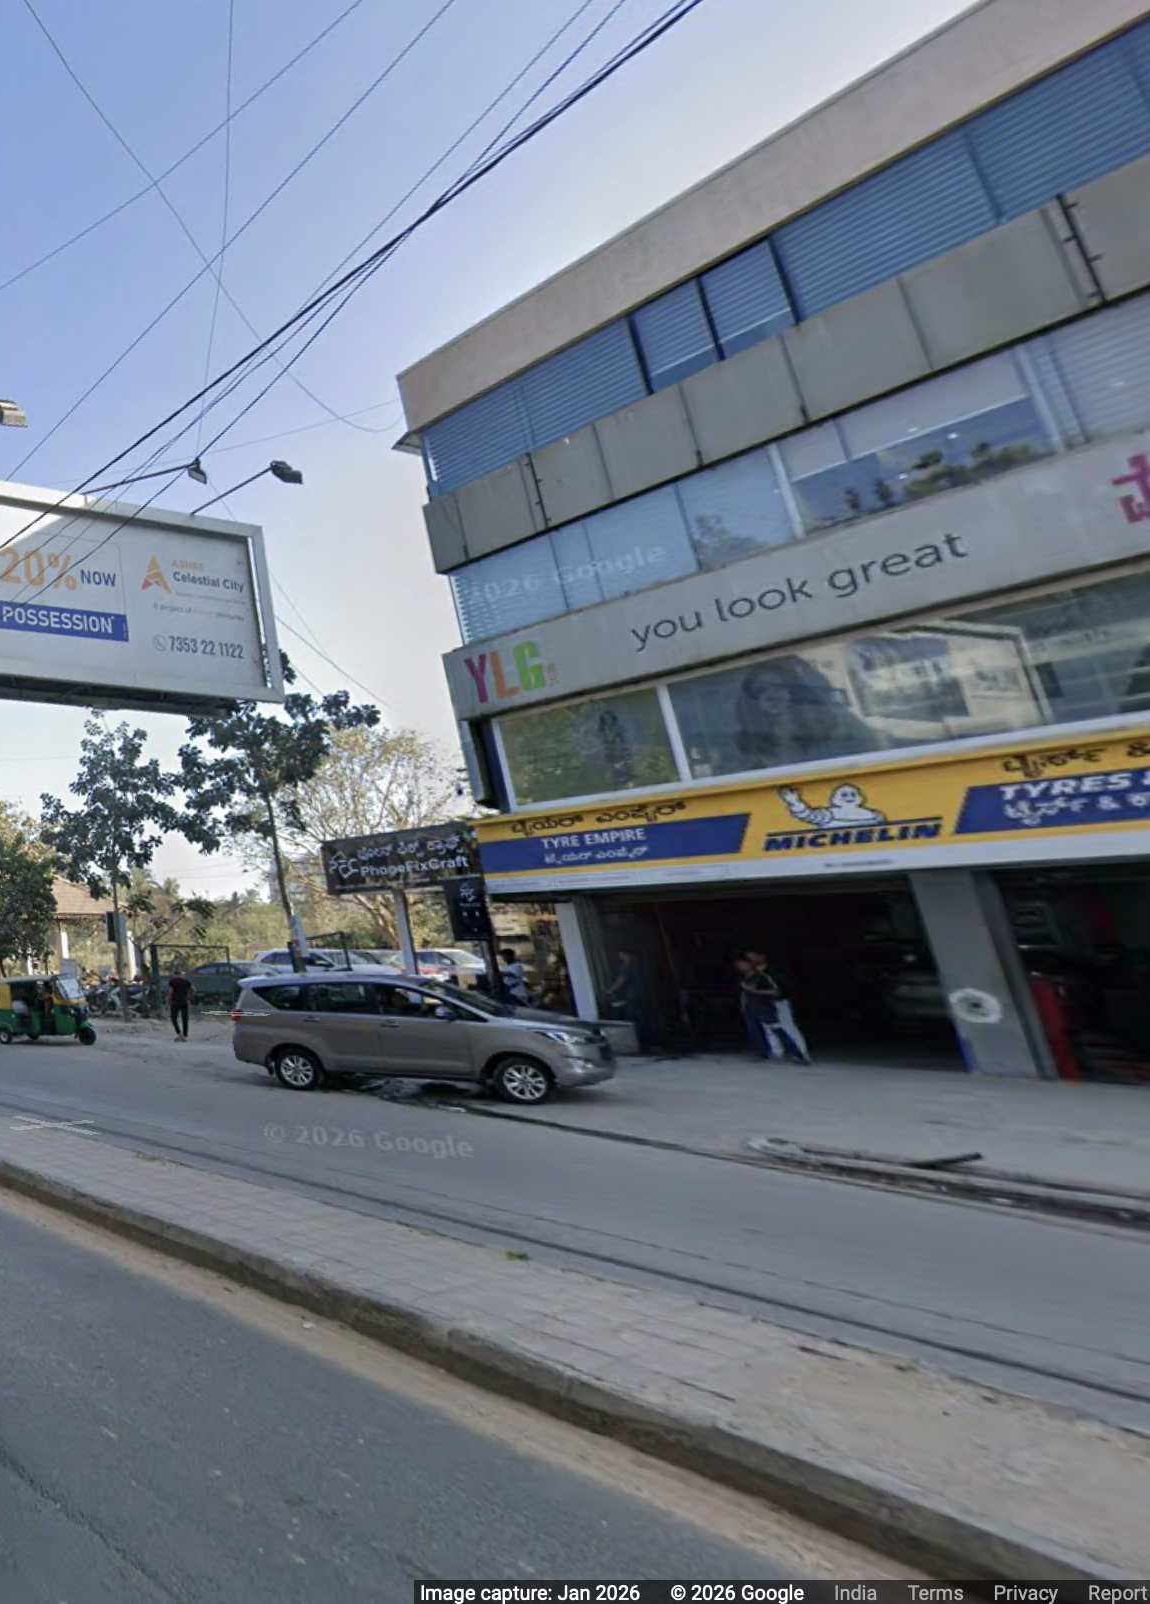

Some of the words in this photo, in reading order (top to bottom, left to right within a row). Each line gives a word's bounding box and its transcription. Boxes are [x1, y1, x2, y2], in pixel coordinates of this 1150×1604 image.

[80, 568, 117, 588] NOW
[172, 571, 221, 588] Celestial
[222, 578, 244, 593] City
[631, 611, 704, 652] you
[714, 578, 813, 623] look
[827, 533, 968, 598] great
[168, 635, 198, 654] 7353
[200, 639, 216, 656] 22
[218, 641, 245, 659] 1122
[463, 640, 548, 703] YLG
[999, 772, 1133, 801] TYRES
[541, 833, 581, 849] TYRE
[584, 827, 647, 846] EMPIRE
[764, 823, 944, 852] MICHELIN
